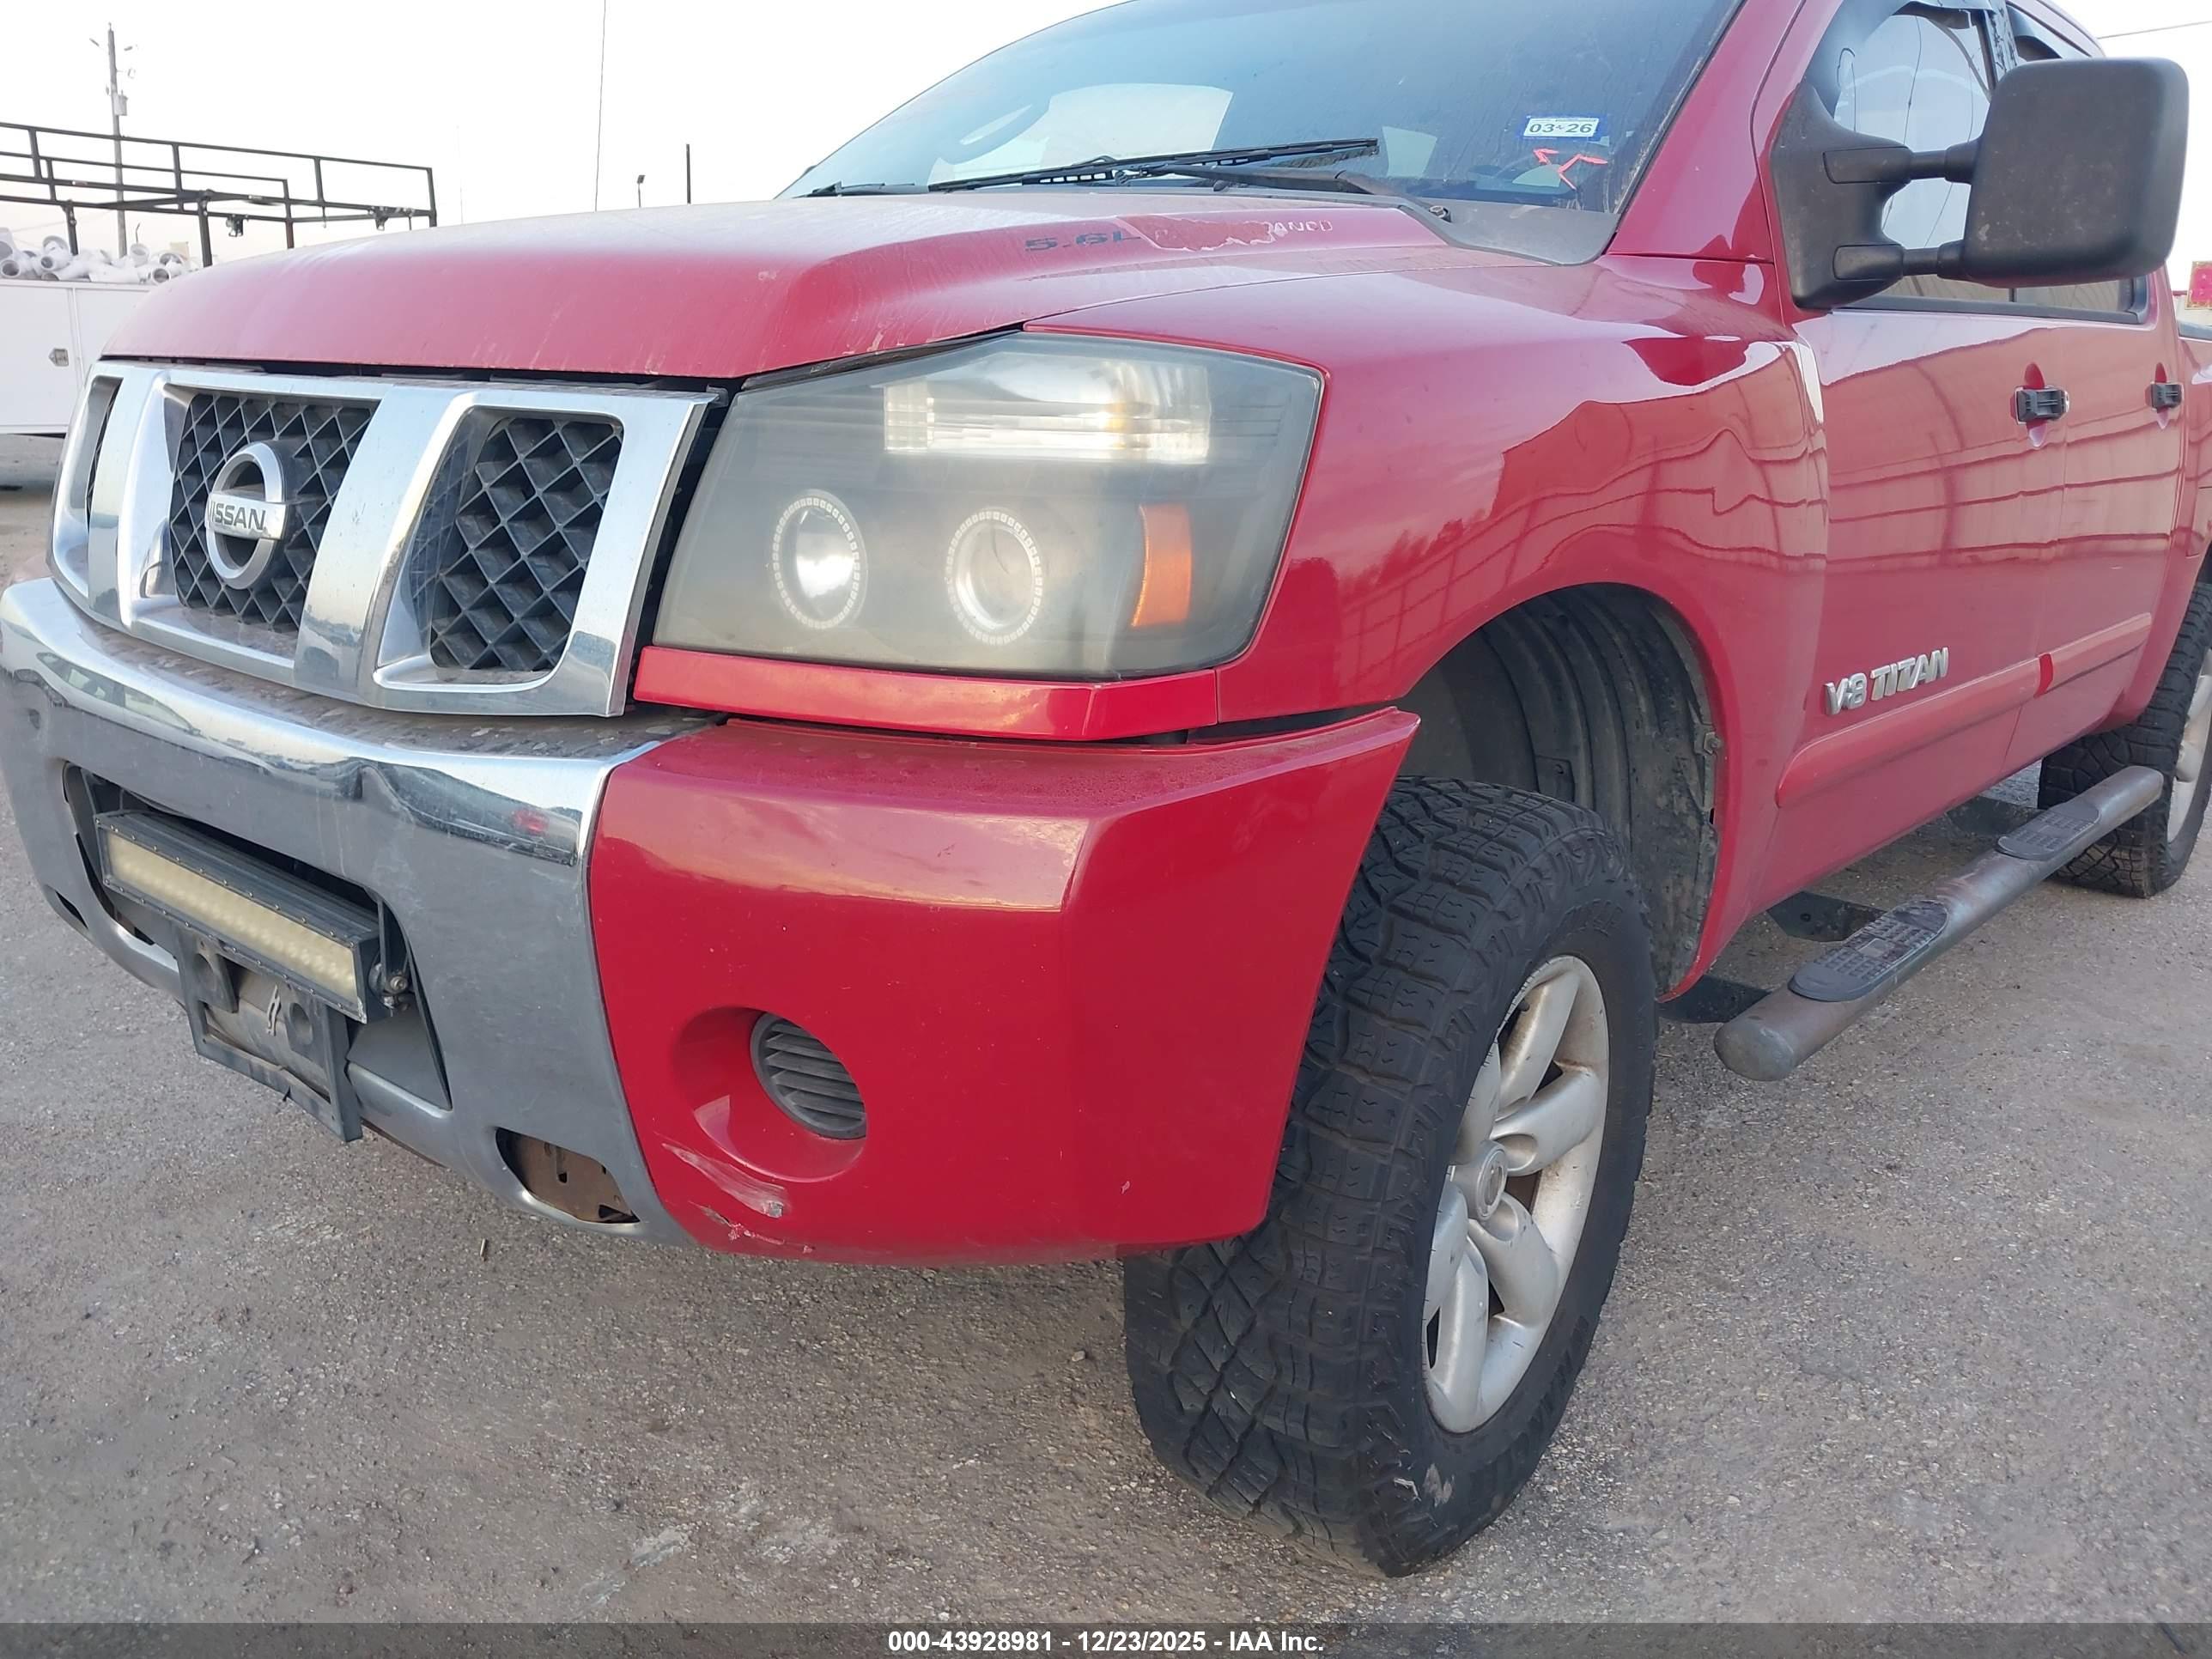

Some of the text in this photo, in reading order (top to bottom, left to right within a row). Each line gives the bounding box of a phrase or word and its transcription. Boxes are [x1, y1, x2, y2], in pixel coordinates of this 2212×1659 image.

[1528, 123, 1594, 134] 03 26
[1024, 230, 1141, 252] 5.6L
[1825, 647, 1949, 715] V8 TITAN
